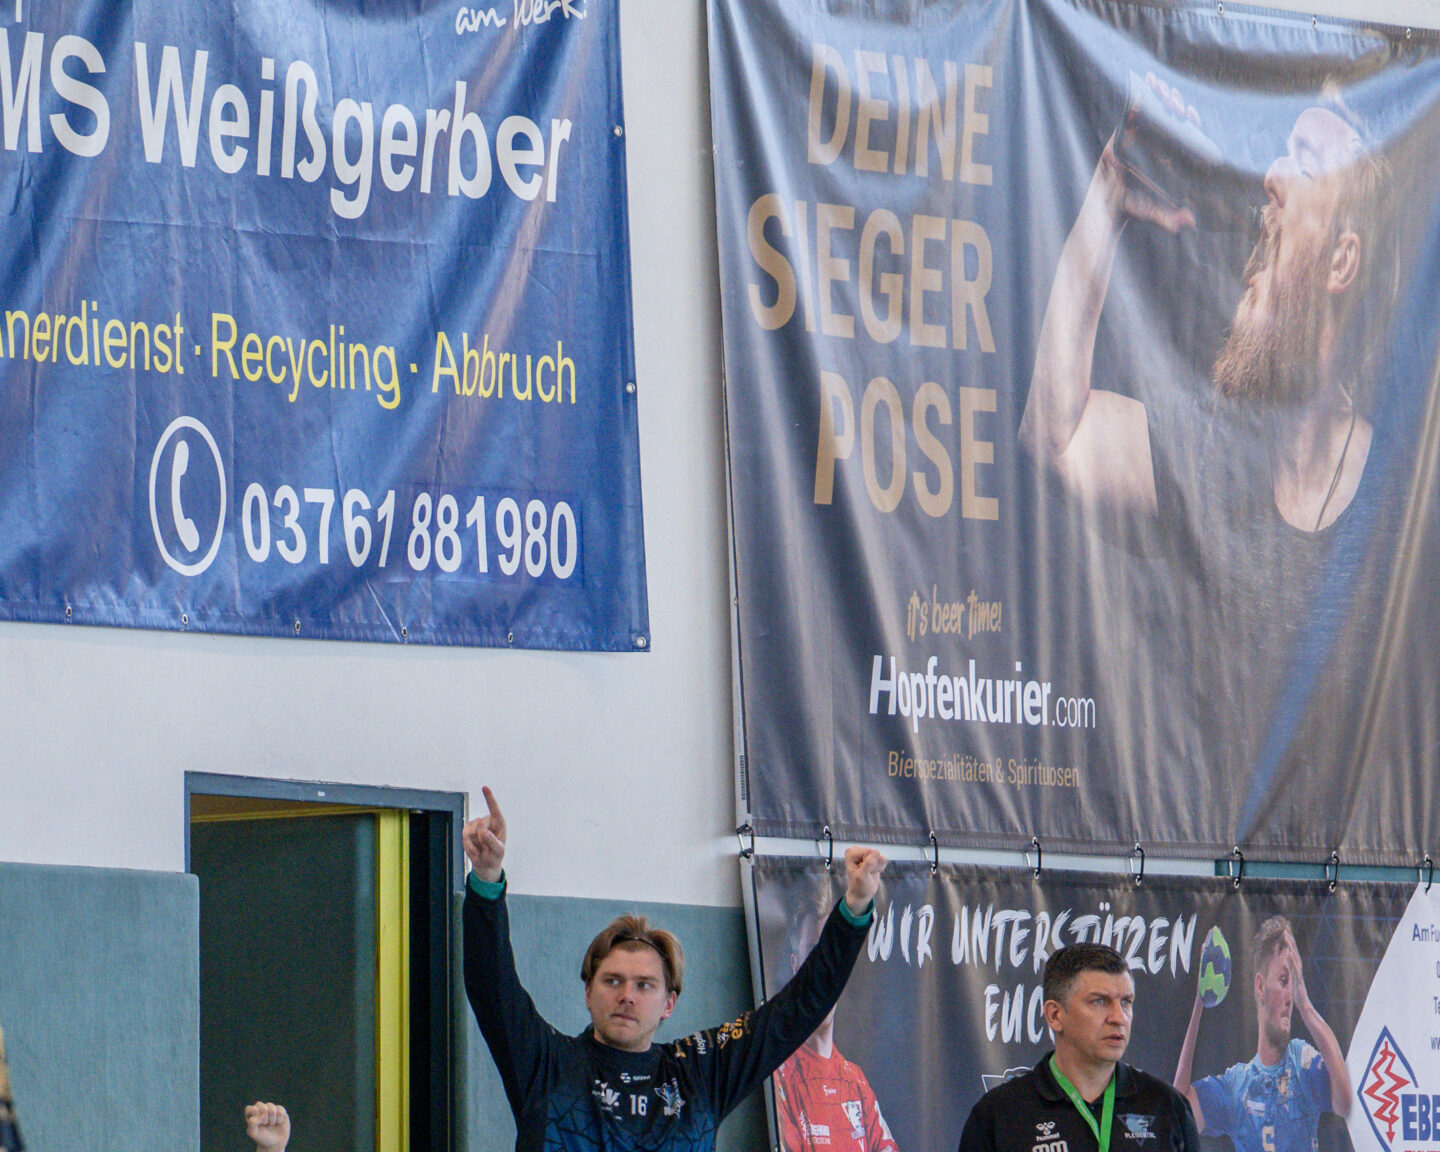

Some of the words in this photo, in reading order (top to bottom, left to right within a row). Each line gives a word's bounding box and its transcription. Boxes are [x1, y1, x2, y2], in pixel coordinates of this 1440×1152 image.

[455, 6, 507, 35] am
[134, 41, 572, 218] Weißgerber
[807, 43, 994, 187] DEINE
[747, 193, 995, 354] SIEGER
[212, 313, 401, 410] Recycling
[432, 332, 577, 404] Abbruch
[814, 369, 999, 521] POSE
[243, 482, 398, 569] 03761
[407, 490, 578, 580] 881980
[869, 654, 1096, 733] Hopfenkurier.com
[1008, 758, 1080, 790] Spirituosen
[867, 900, 935, 969] WIR
[984, 983, 1057, 1045] EUC
[629, 1094, 648, 1117] 16
